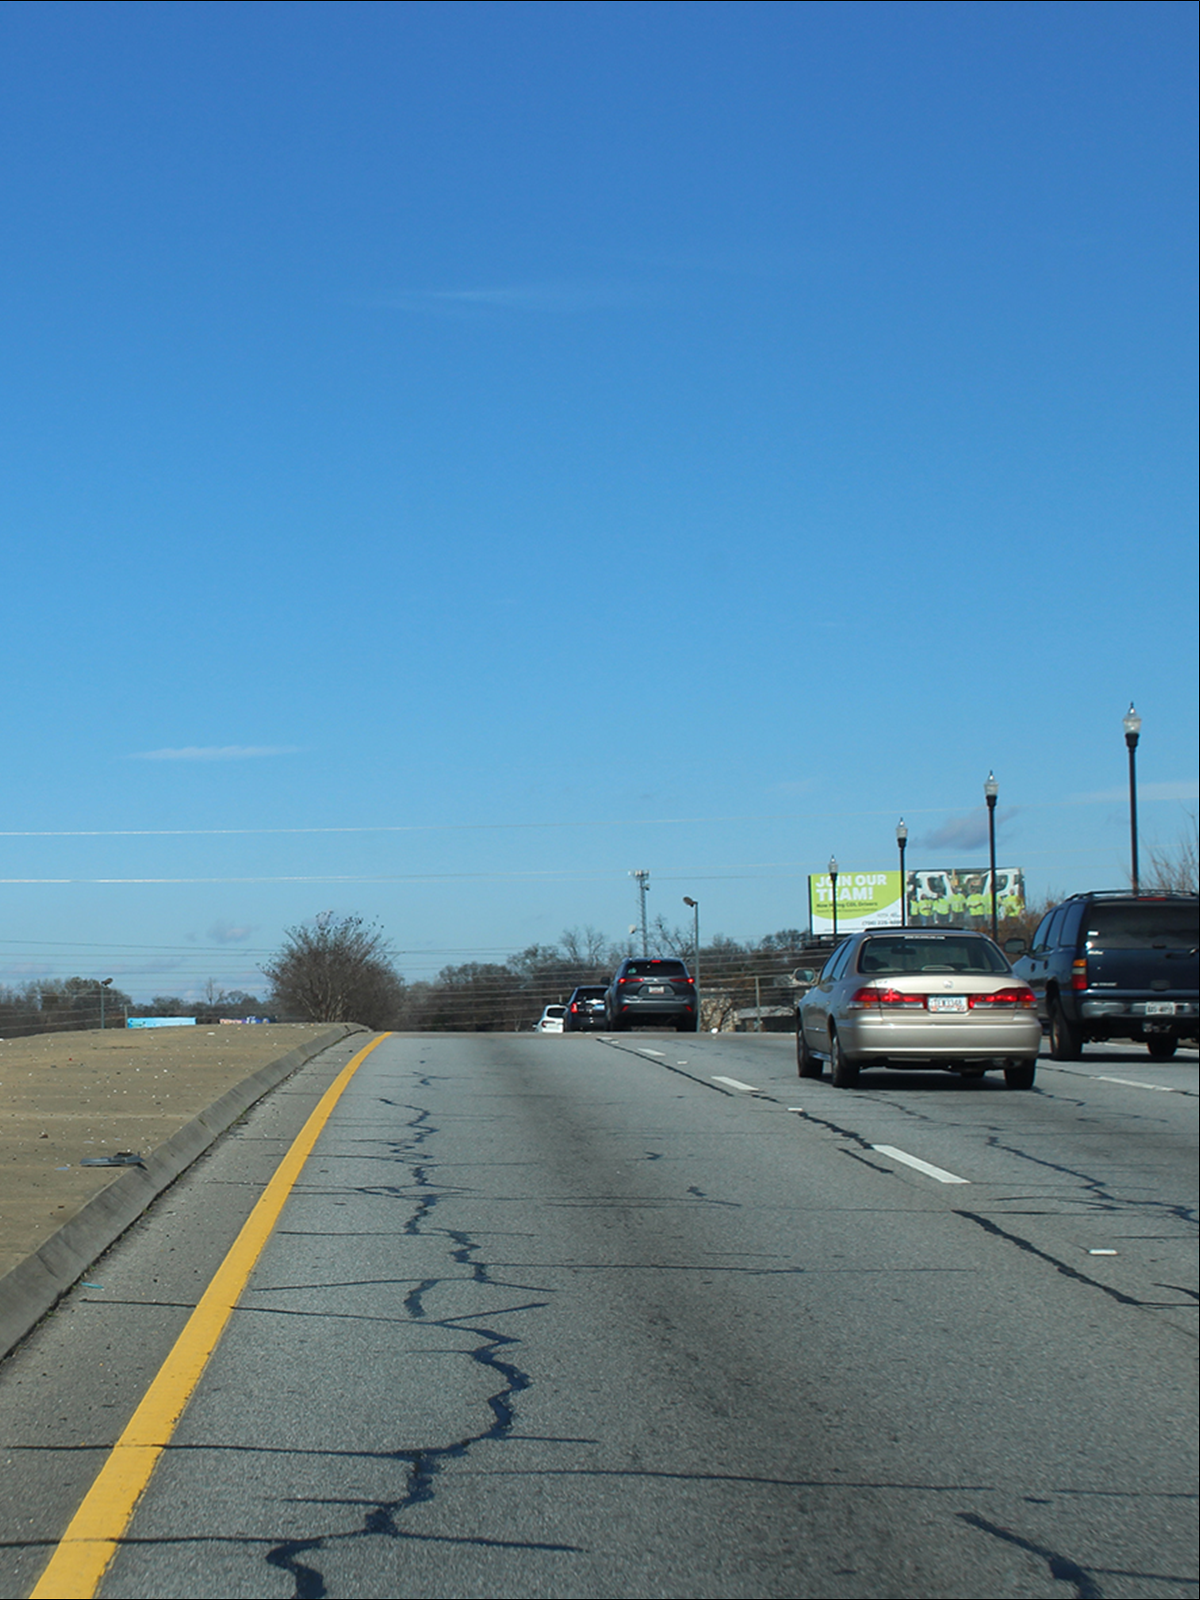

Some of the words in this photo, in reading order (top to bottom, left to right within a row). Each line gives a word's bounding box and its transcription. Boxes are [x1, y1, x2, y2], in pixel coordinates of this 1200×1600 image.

[815, 875, 852, 888] JOIN
[855, 874, 887, 886] OUR
[815, 887, 874, 902] TEAM!
